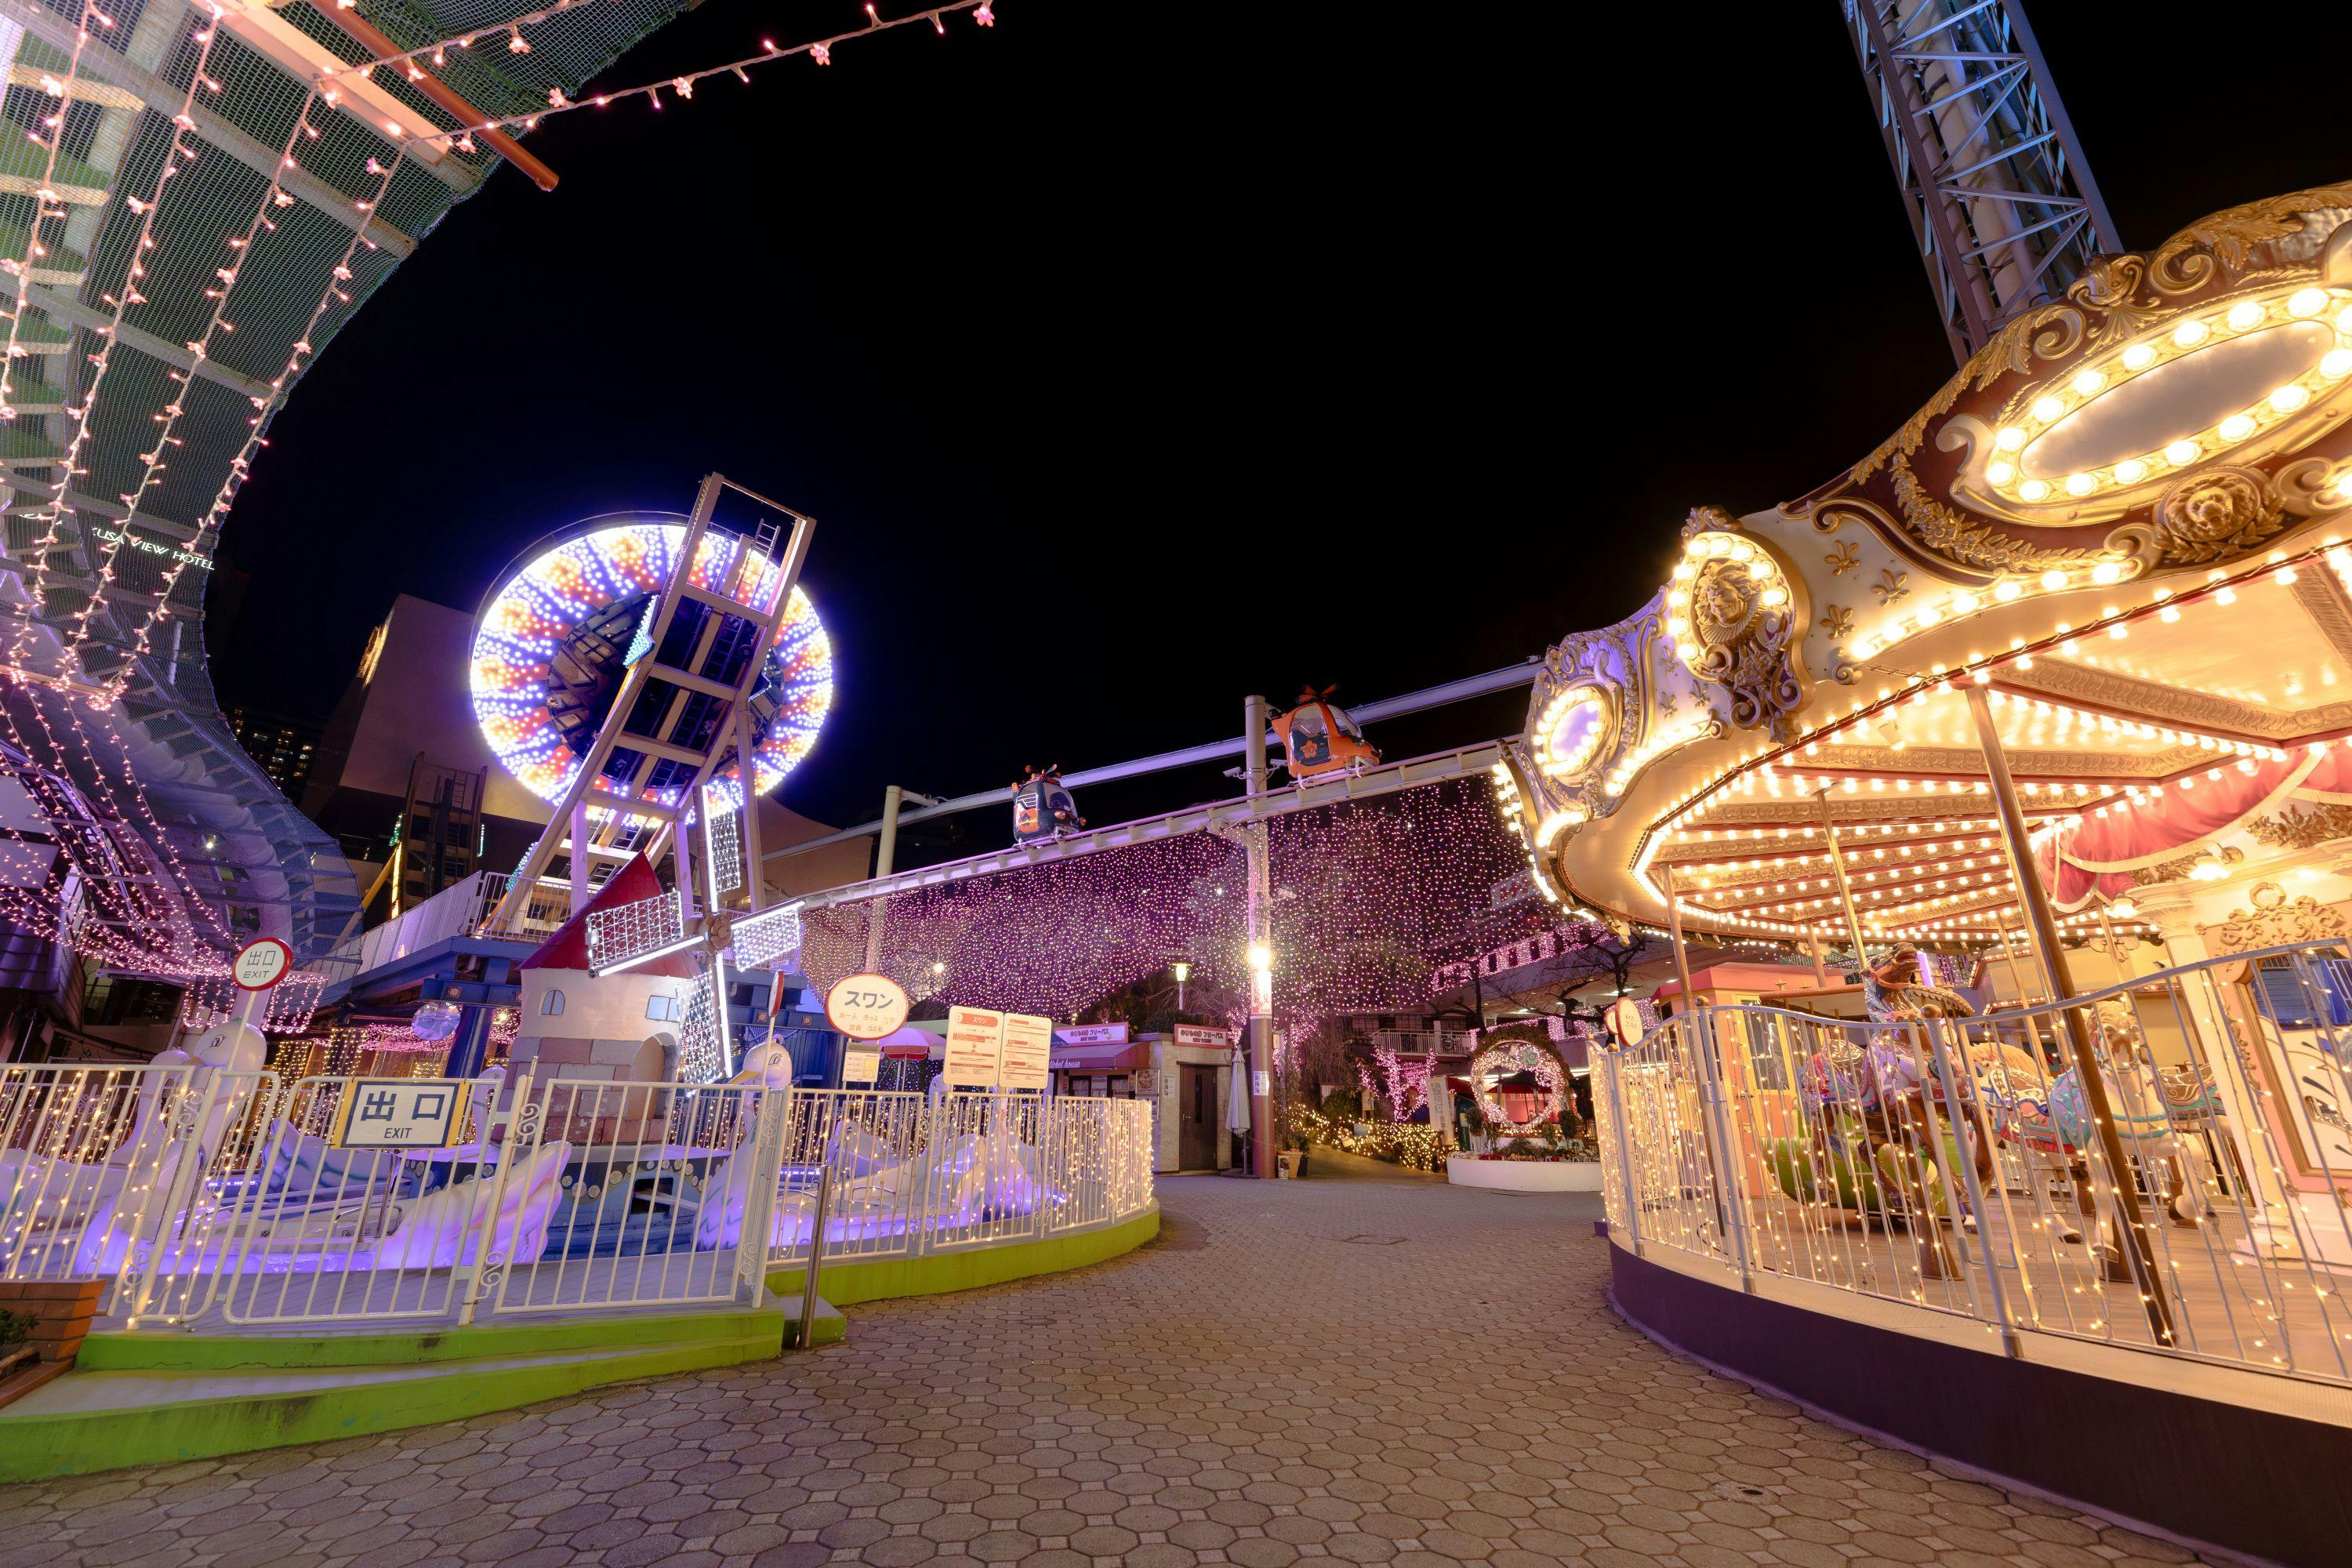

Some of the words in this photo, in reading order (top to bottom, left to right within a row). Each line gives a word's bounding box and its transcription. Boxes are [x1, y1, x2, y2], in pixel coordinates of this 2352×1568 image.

[172, 550, 215, 570] HOTEL
[246, 950, 276, 966] 出口
[243, 970, 270, 978] EXIT
[844, 990, 893, 1009] スワン
[360, 1091, 446, 1122] 出口
[383, 1127, 412, 1138] EXIT
